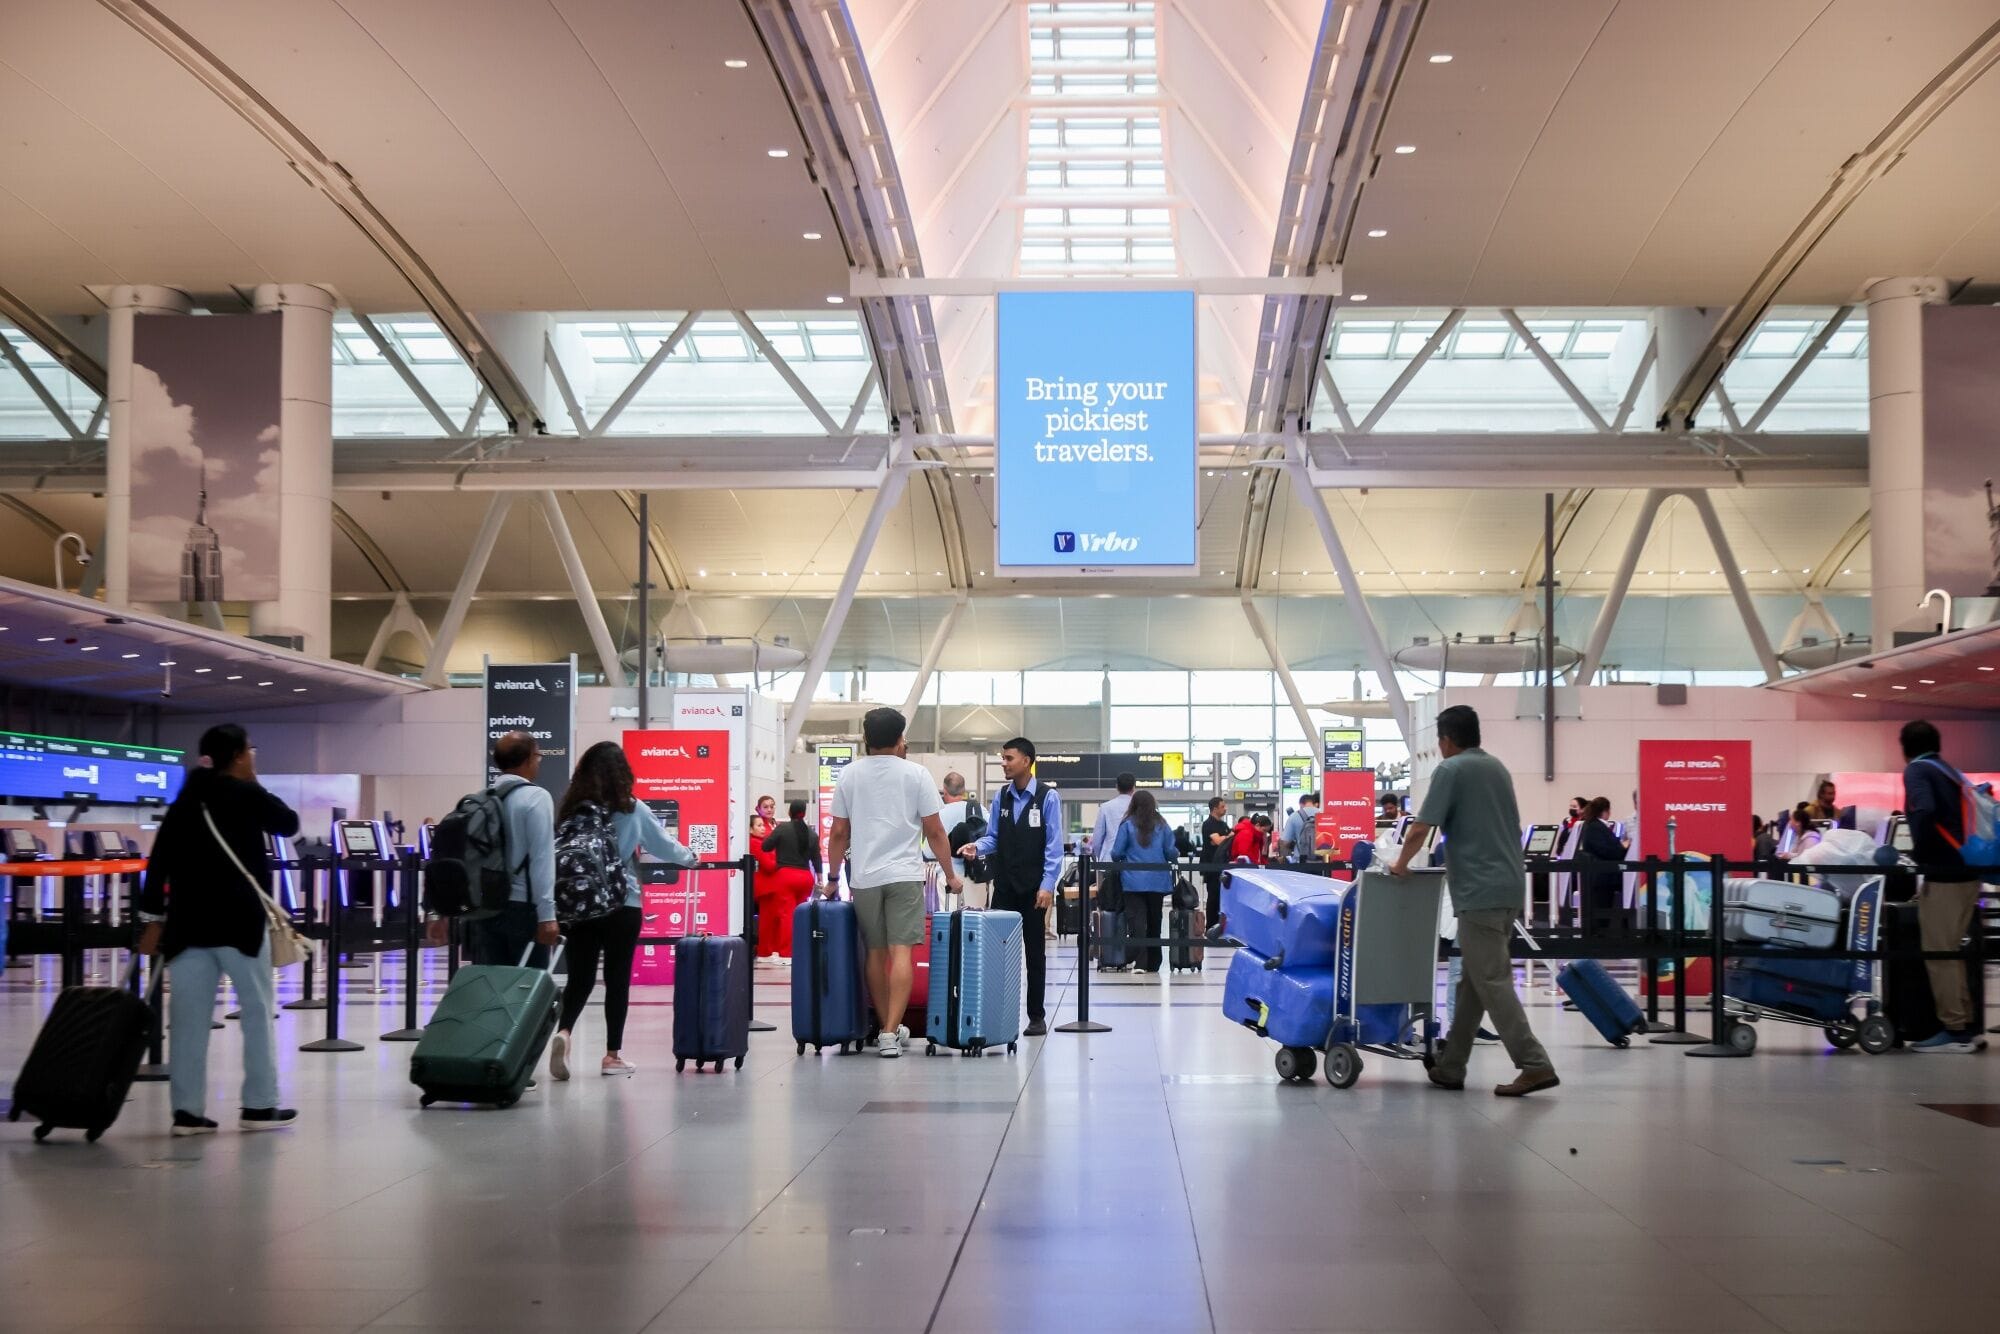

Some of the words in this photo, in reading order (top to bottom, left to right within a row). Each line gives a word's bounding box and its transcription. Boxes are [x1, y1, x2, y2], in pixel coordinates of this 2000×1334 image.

[1026, 376, 1098, 405] Bring
[1106, 381, 1168, 405] your
[1045, 408, 1148, 437] pickiest
[1034, 439, 1154, 462] travelers.
[1080, 531, 1139, 552] Vrbo
[494, 680, 535, 690] avianca
[681, 706, 715, 715] avianca
[489, 716, 535, 727] priority
[489, 730, 552, 739] cusers
[641, 746, 679, 757] avianca
[1351, 742, 1360, 751] 6
[821, 757, 829, 765] 7
[1664, 803, 1727, 812] NAMASTE
